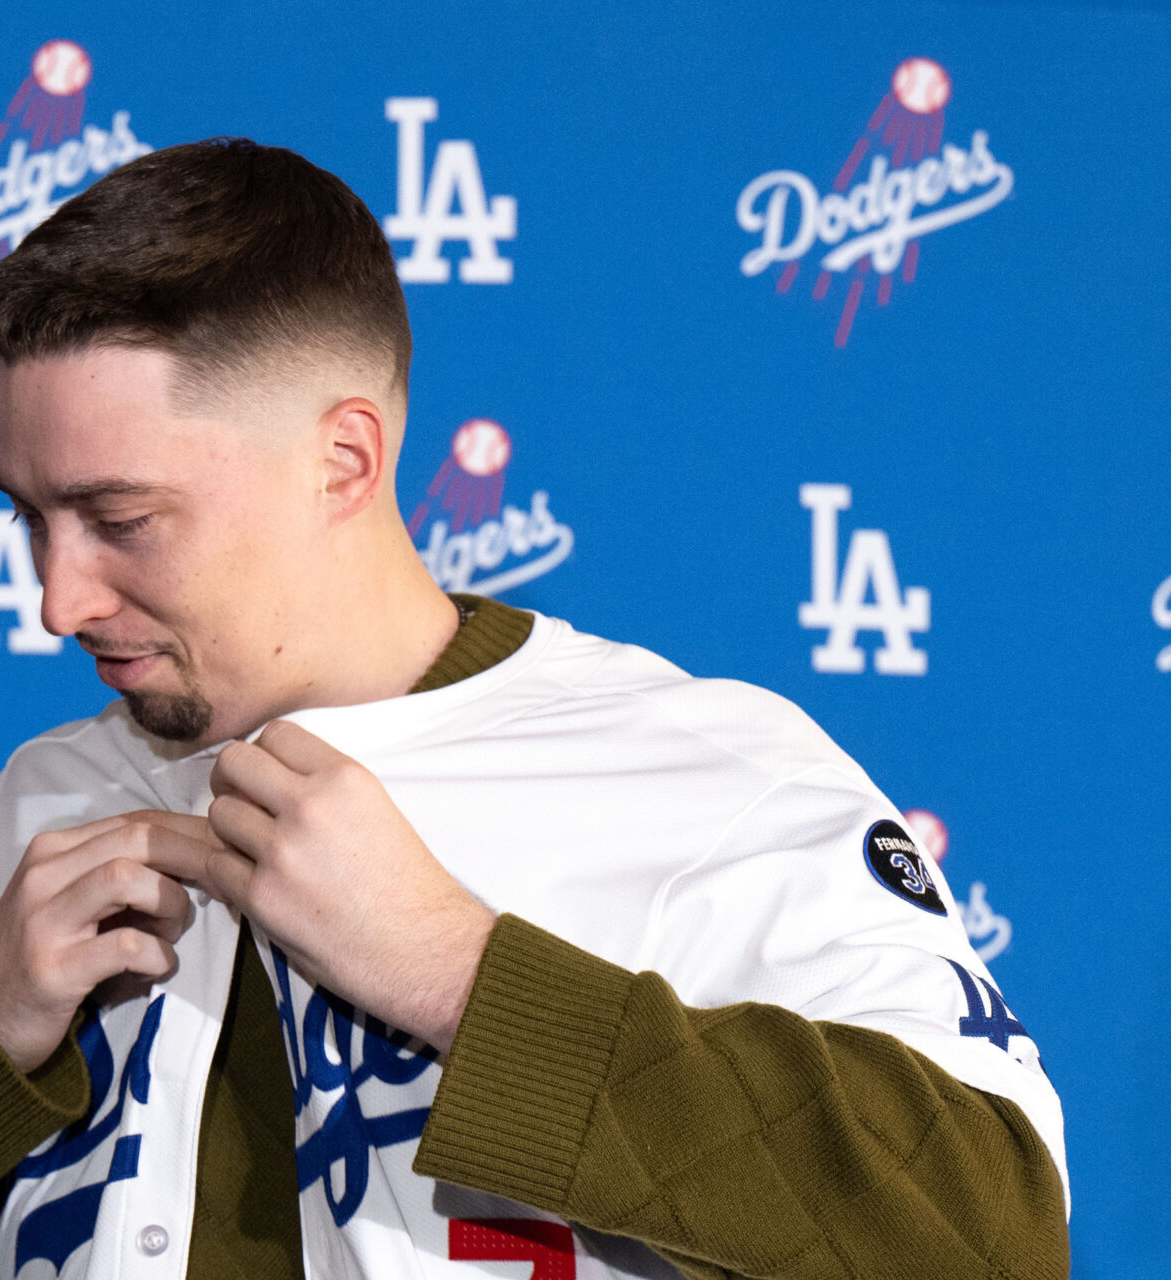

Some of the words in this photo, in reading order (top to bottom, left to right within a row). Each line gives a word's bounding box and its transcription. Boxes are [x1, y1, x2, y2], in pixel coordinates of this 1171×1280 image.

[383, 98, 517, 283] LA
[737, 131, 1014, 276] Dodgers
[799, 484, 930, 675] LA
